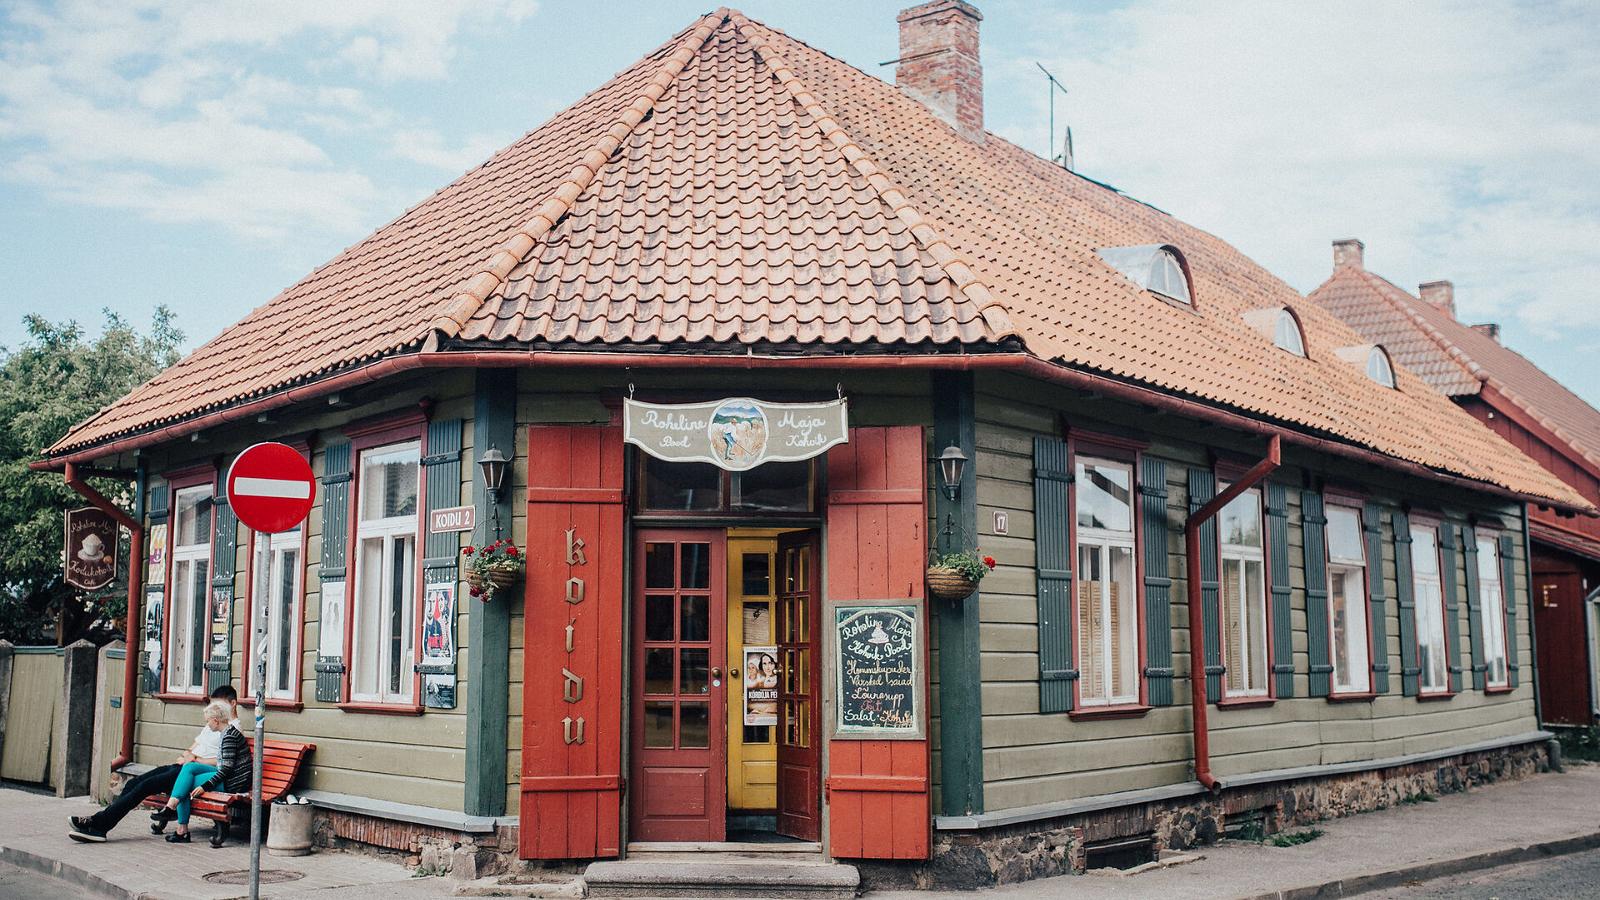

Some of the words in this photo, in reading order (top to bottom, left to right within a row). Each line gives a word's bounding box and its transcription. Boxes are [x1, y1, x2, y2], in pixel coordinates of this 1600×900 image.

[641, 410, 707, 429] Roheline
[777, 411, 826, 437] Maja
[659, 435, 691, 448] Pood
[786, 434, 827, 447] Kohvik
[435, 511, 462, 528] KOIDU
[464, 510, 470, 525] 2
[997, 515, 1006, 530] 17
[844, 709, 877, 721] Salat
